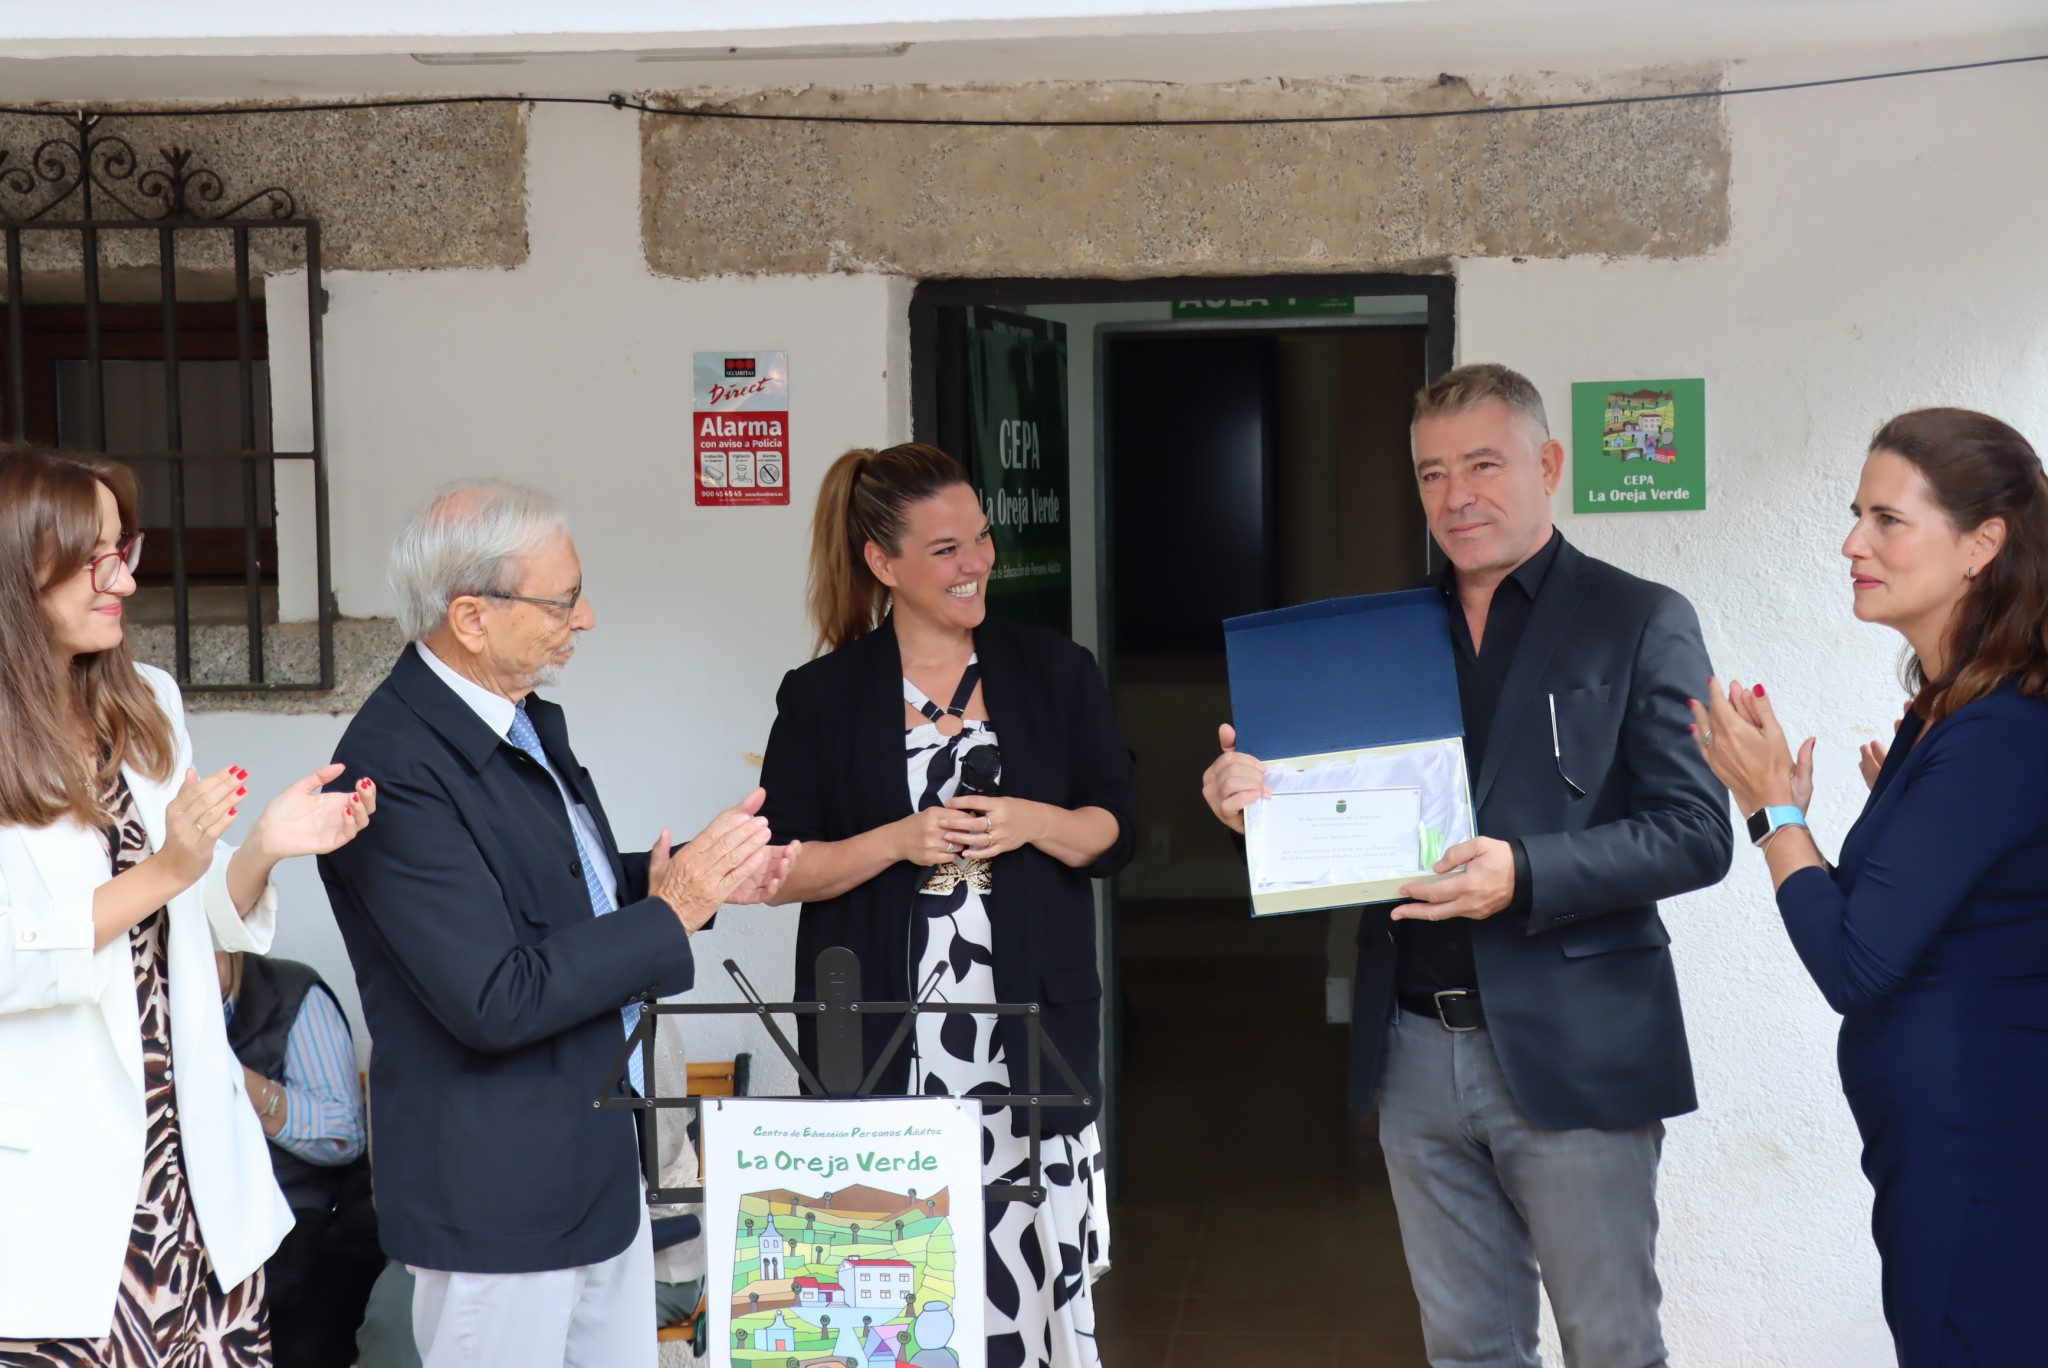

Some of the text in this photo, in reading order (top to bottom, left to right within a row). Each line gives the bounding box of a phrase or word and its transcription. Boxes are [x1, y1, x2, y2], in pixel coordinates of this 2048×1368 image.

[708, 377, 774, 405] Direct
[701, 416, 783, 437] Alarma
[719, 440, 742, 448] aviso
[752, 438, 783, 448] Policía
[1000, 419, 1040, 469] CEPA
[1623, 475, 1655, 486] CEPA
[1589, 487, 1690, 503] La Oreja Verde
[997, 488, 1029, 533] Oreja
[1032, 488, 1060, 523] Verde
[753, 1125, 943, 1138] Centro de Educación Personas Adultas
[737, 1149, 939, 1178] La Oreja Verde
